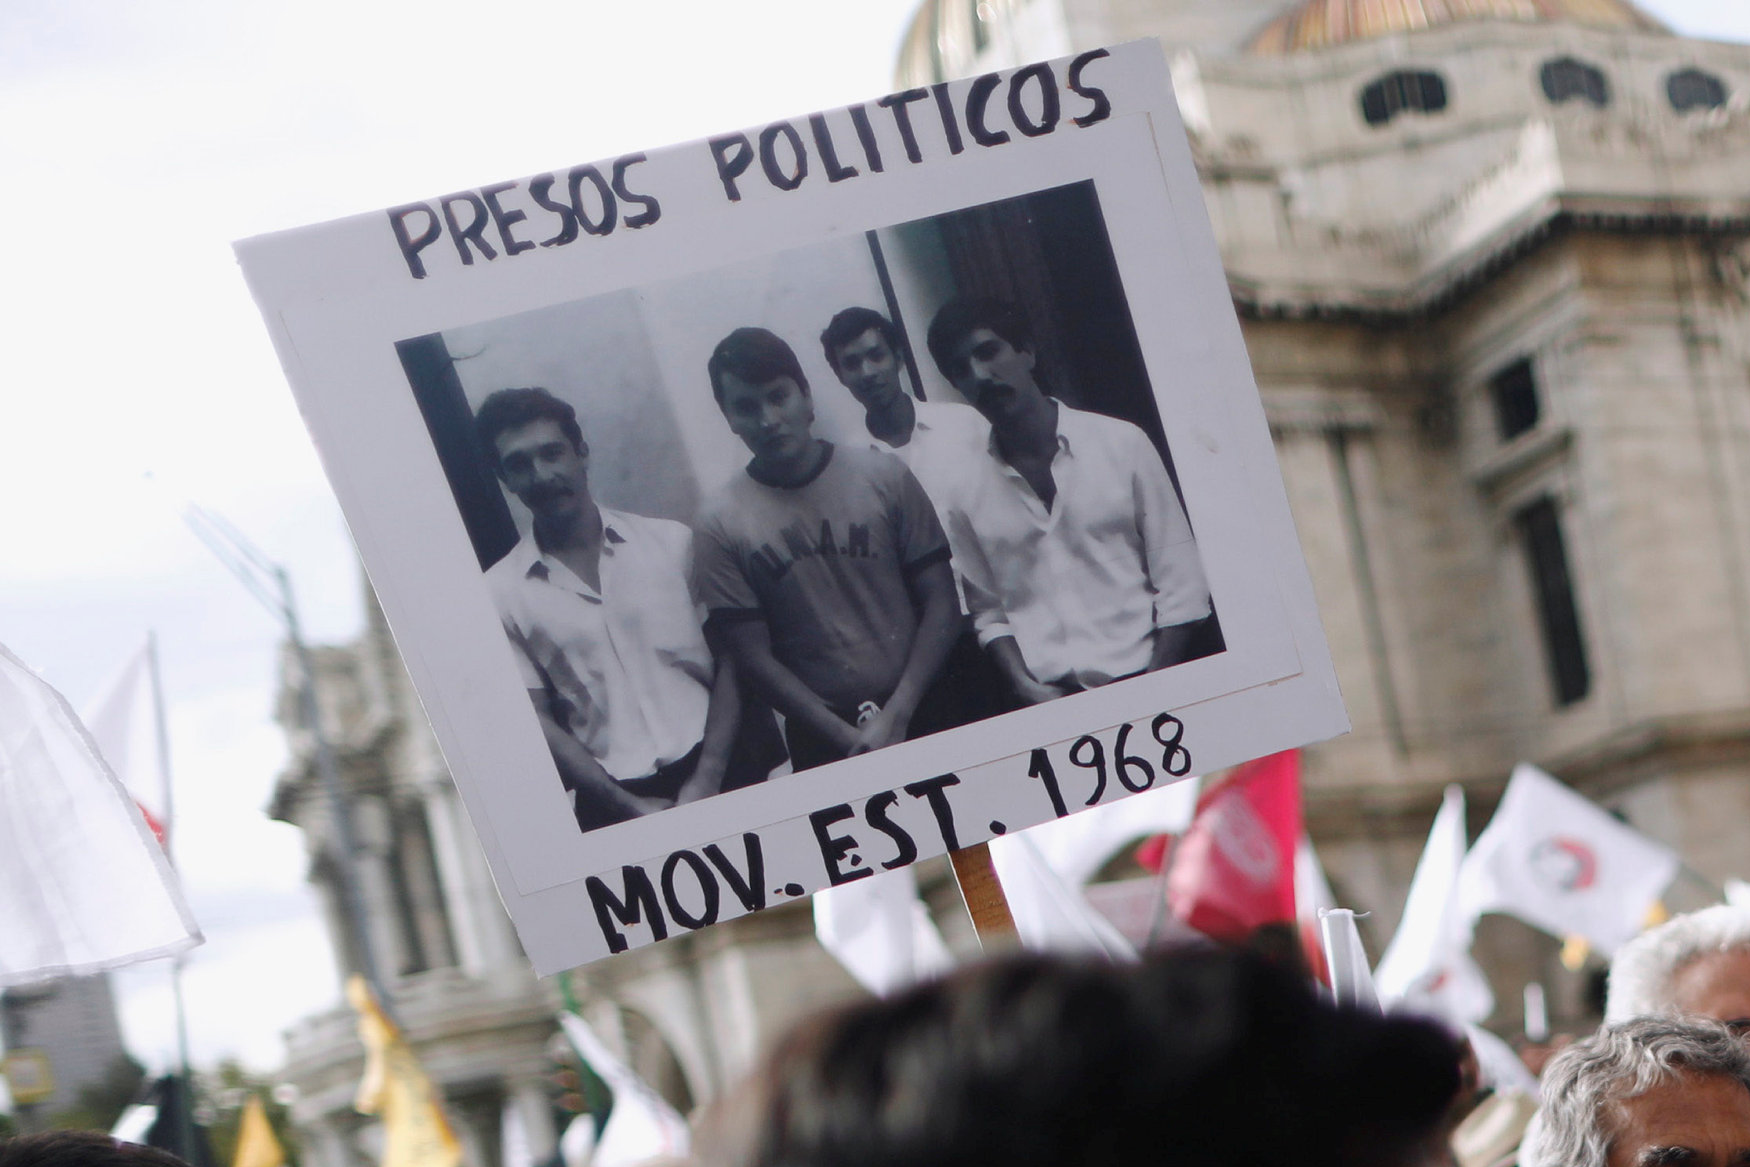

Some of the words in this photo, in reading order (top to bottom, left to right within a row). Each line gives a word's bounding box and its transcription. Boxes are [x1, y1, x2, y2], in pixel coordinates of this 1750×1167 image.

[386, 151, 661, 279] PRESOS
[708, 48, 1112, 201] POLITICOS
[585, 832, 805, 954] MOV.
[809, 773, 1007, 888] EST.
[1028, 712, 1192, 817] 1968
